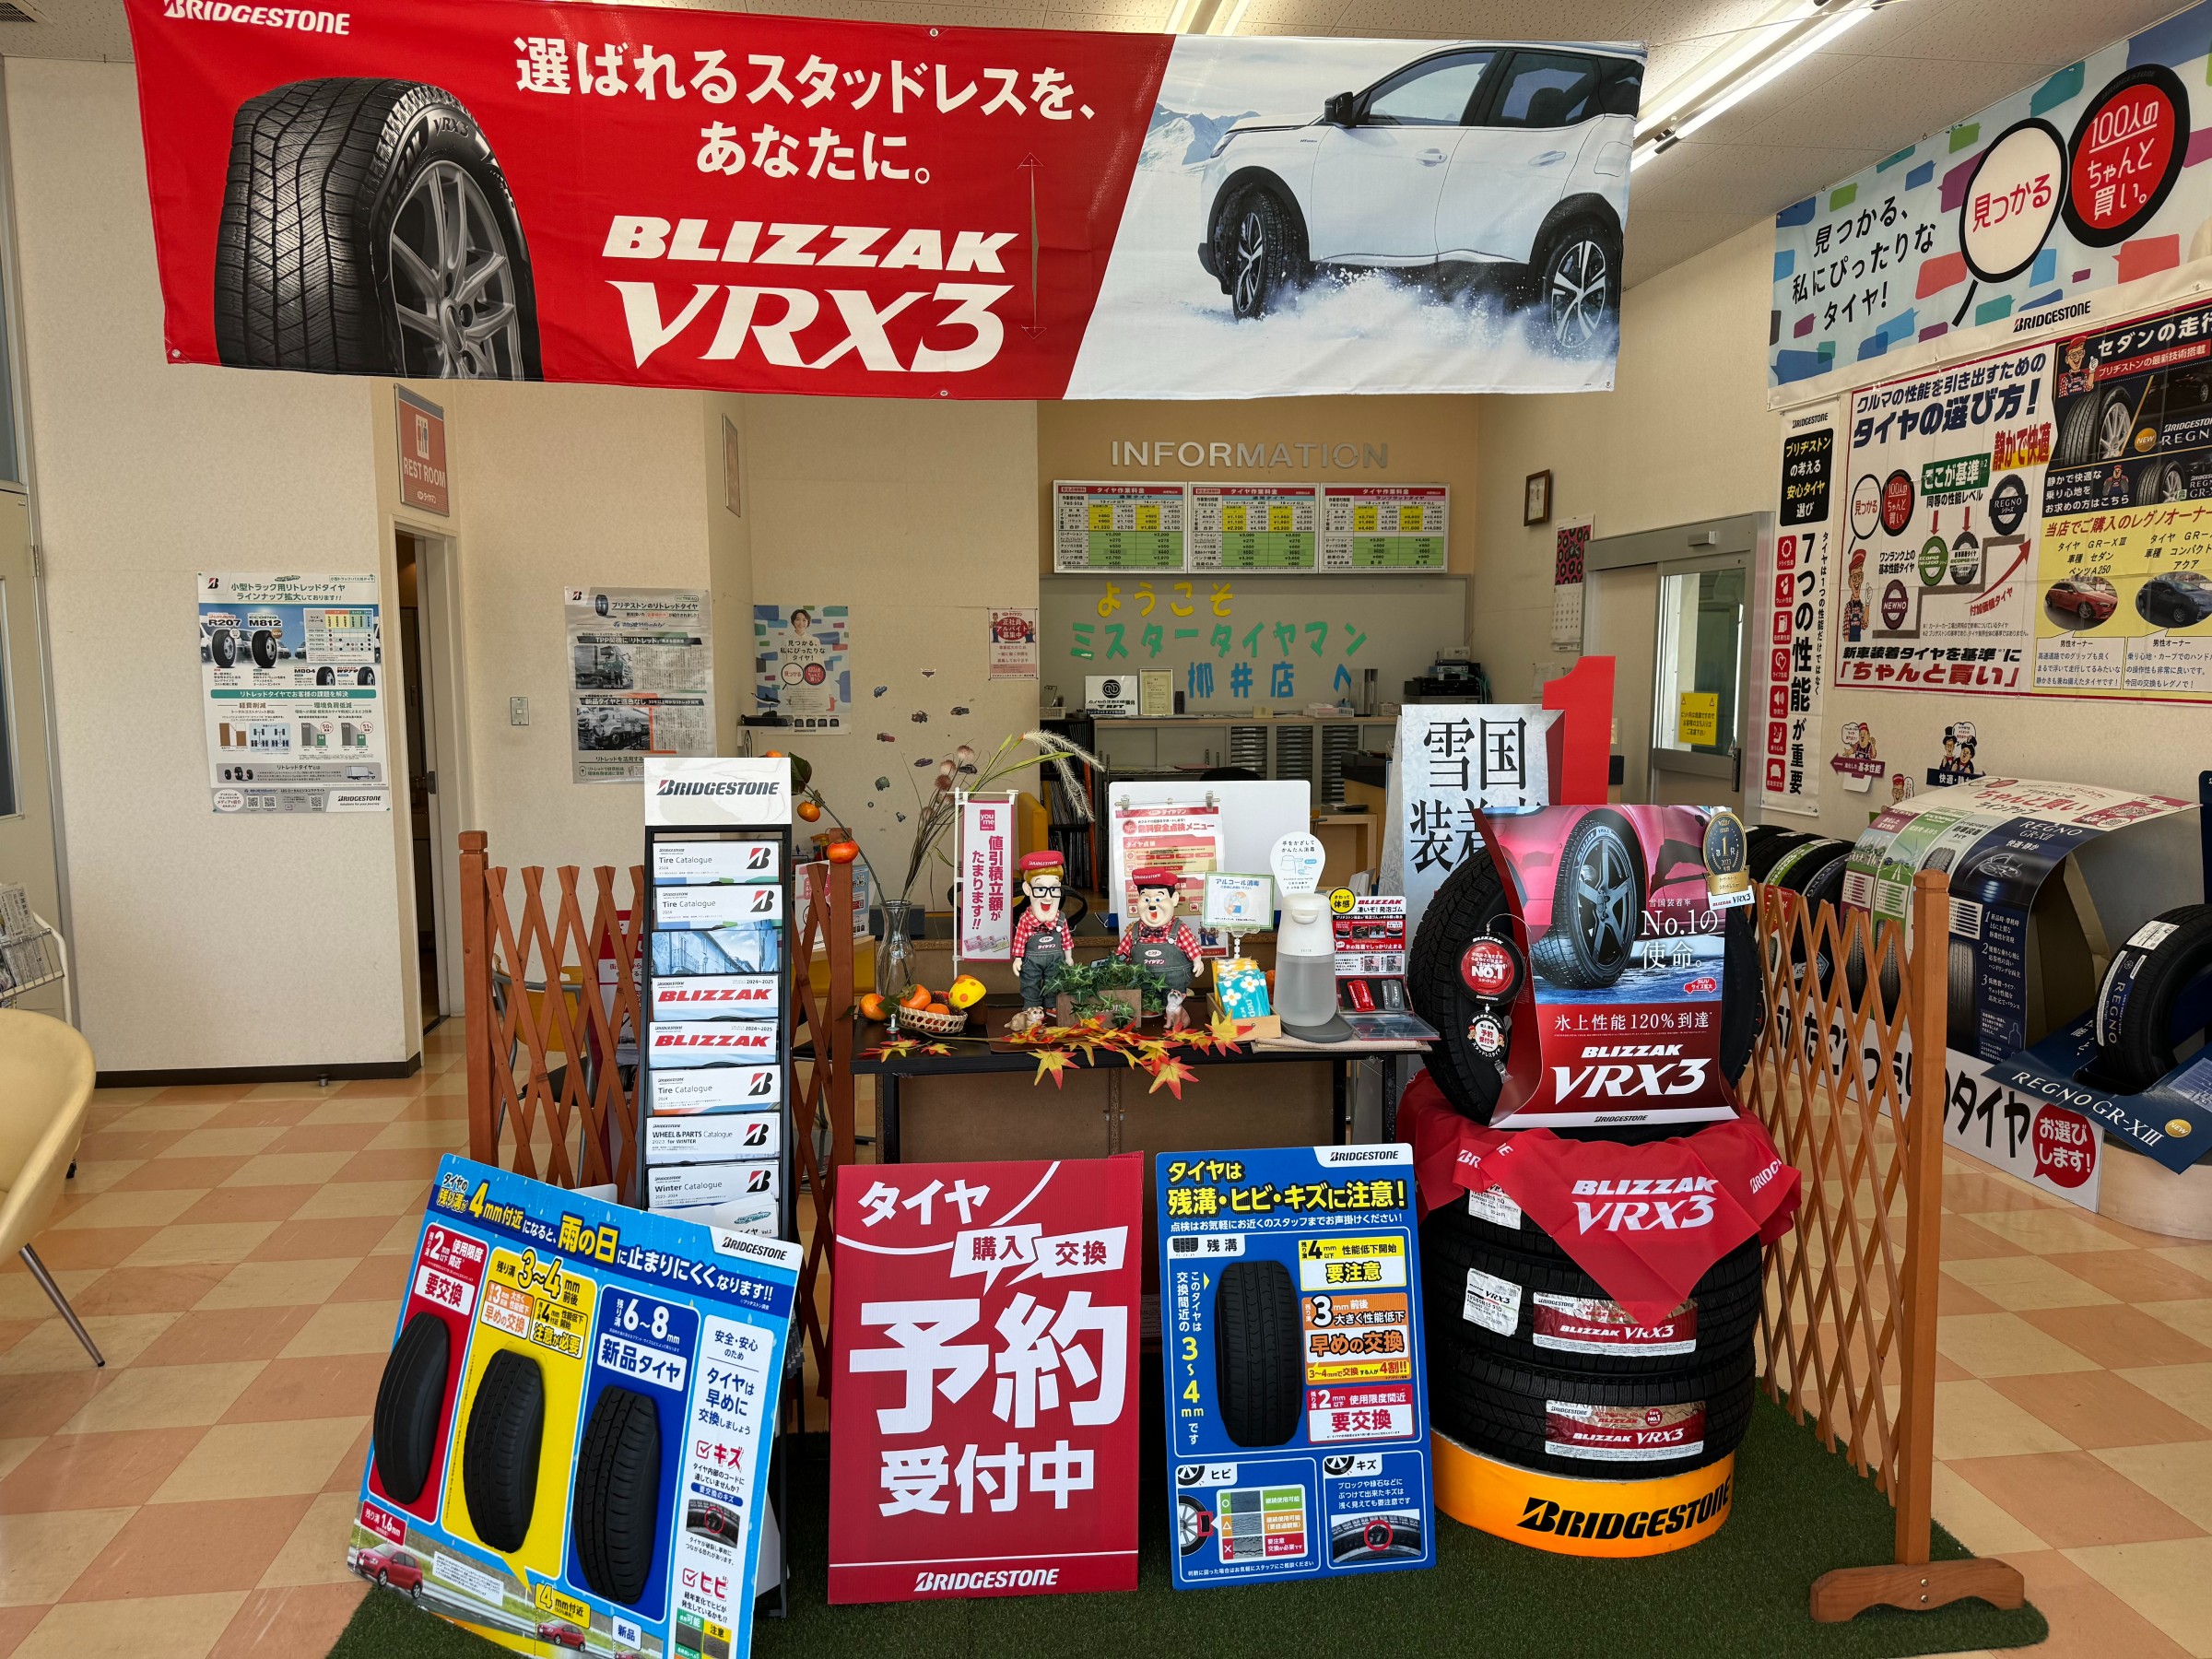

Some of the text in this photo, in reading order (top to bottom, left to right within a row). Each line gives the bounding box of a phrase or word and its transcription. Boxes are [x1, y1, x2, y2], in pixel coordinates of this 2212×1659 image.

[164, 0, 350, 35] BRIDGESTONE
[513, 37, 1096, 121] 選ばれるスタッドレスを、
[2090, 100, 2159, 148] 100人の
[696, 121, 931, 185] あなたに。
[2087, 135, 2155, 189] ちゃんと
[1971, 173, 2053, 233] 見つかる
[2093, 183, 2147, 222] 買い。
[1813, 194, 1909, 258] 見つかる、
[602, 215, 1018, 274] BLIZZAK
[1792, 223, 1937, 305] 私にぴったりな
[1823, 280, 1888, 331] タイヤ!
[2013, 300, 2092, 335] BRIDGESTONE
[605, 279, 1015, 373] VRX3
[1856, 352, 2047, 415] クルマの性能を引き出すための
[1853, 377, 2041, 450] タイヤの選び方!
[1112, 441, 1388, 468] INFORMATION
[404, 457, 446, 488] REST ROOM
[1790, 459, 1821, 477] の考える
[2047, 470, 2102, 488] 静かで快適な
[1786, 480, 1826, 500] 安心タイヤ
[1926, 489, 1983, 508] 同等の性能レベル
[2046, 486, 2091, 500] 乗り心地を
[1796, 501, 1814, 519] 選び
[2045, 494, 2130, 513] お求めの方はこちら
[2057, 540, 2080, 552] タイヤ
[2150, 532, 2176, 544] タイヤ
[2090, 551, 2114, 562] セダン
[230, 582, 346, 593] 小型トラック用リトレッドタイヤ
[1097, 582, 1234, 618] ようこそ
[208, 618, 241, 628] R207
[249, 618, 282, 628] M812
[780, 646, 826, 654] 私にぴったりな
[1070, 620, 1368, 661] ミスタータイヤマン
[1789, 532, 1817, 795] 7つの性能が重要
[1841, 662, 2019, 688] 「ちゃんと買い」
[1187, 661, 1295, 700] 柳井店
[1423, 717, 1528, 792] 雪国
[656, 779, 781, 796] BRIDGESTONE
[980, 814, 994, 823] you
[2018, 820, 2084, 837] REGNO
[676, 856, 712, 865] Catalogue
[971, 850, 985, 931] たまります!!
[988, 835, 1004, 922] 値引積立額が
[679, 900, 716, 909] Catalogue
[1334, 900, 1351, 909] 体感
[1641, 909, 1718, 936] No.1の
[1640, 940, 1703, 971] 使命。
[657, 988, 773, 1003] BLIZZAK
[2108, 981, 2126, 1044] REGNO
[654, 1034, 772, 1047] BLIZZAK
[1478, 1037, 1495, 1045] 受付中
[1581, 1043, 1684, 1059] BLIZZAK
[675, 1085, 713, 1095] Catalogue
[1549, 1057, 1712, 1105] VRX3
[2010, 1071, 2093, 1106] REGNO
[1593, 1112, 1649, 1124] BRIDGESTONE
[2040, 1114, 2088, 1145] お選び
[703, 1129, 733, 1139] Catalogue
[1330, 1150, 1399, 1162] BRIDGESTONE
[2038, 1141, 2091, 1171] します!
[443, 1173, 469, 1193] タイヤの
[1168, 1160, 1242, 1182] タイヤは
[654, 1181, 723, 1193] Winter Catalogue
[1571, 1176, 1719, 1195] BLIZZAK
[436, 1188, 467, 1214] 残り溝が
[858, 1179, 991, 1228] タイヤ
[1168, 1180, 1406, 1216] 残溝・ヒビ・キズに注意!
[1171, 1213, 1404, 1232] 点検はお気軽にお近くのスタッフまでお声掛けください!
[1571, 1194, 1718, 1236] VRX3
[722, 1236, 788, 1262] BRIDGESTONE
[971, 1235, 1108, 1266] 購入 交換
[1206, 1238, 1238, 1253] 残溝
[1342, 1243, 1397, 1255] 性能低下開始
[495, 1260, 516, 1278] 残り溝
[1325, 1262, 1382, 1283] 要注意
[425, 1272, 465, 1309] 要交換
[1176, 1271, 1190, 1333] 交換間近の
[1190, 1271, 1202, 1332] このタイヤは
[1537, 1298, 1576, 1308] BRIDGESTONE
[484, 1306, 526, 1335] 早めの交換
[1334, 1311, 1406, 1325] 大きく性能低下
[1559, 1324, 1621, 1336] BLIZZAK
[533, 1321, 582, 1354] 注意が必要
[714, 1329, 759, 1353] 安全・安心
[1310, 1332, 1405, 1357] 早めの交換
[601, 1337, 682, 1383] 新品タイヤ
[724, 1347, 745, 1361] のため
[849, 1290, 1128, 1435] 予約
[707, 1367, 755, 1396] タイヤは
[705, 1388, 748, 1417] 早めに
[1550, 1406, 1588, 1417] BRIDGESTONE
[698, 1408, 751, 1435] 交換しましょう
[1331, 1409, 1393, 1433] 要交換
[1572, 1428, 1685, 1445] BLIZZAK VRX3
[713, 1442, 745, 1474] キズ
[1356, 1459, 1377, 1471] キズ
[693, 1462, 745, 1486] タイヤ内部のコードに
[694, 1472, 740, 1494] 達していませんか?
[878, 1440, 1095, 1518] 受付中
[1210, 1468, 1231, 1480] ヒビ
[1338, 1478, 1403, 1489] ブロックや縁石などに
[699, 1484, 735, 1504] 要交換のキズ
[1338, 1488, 1404, 1500] ぶつけて出来たキズは
[1338, 1498, 1411, 1510] 浅く見えても要注意です
[1516, 1477, 1732, 1540] BRIDGESTONE
[685, 1543, 735, 1566] つながる恐れがあります。
[700, 1571, 729, 1602] ヒビ
[913, 1568, 1060, 1592] BRIDGESTONE
[684, 1591, 727, 1614] 経年変化でヒビが
[618, 1622, 636, 1641] 新品
[709, 1624, 725, 1639] 注意
